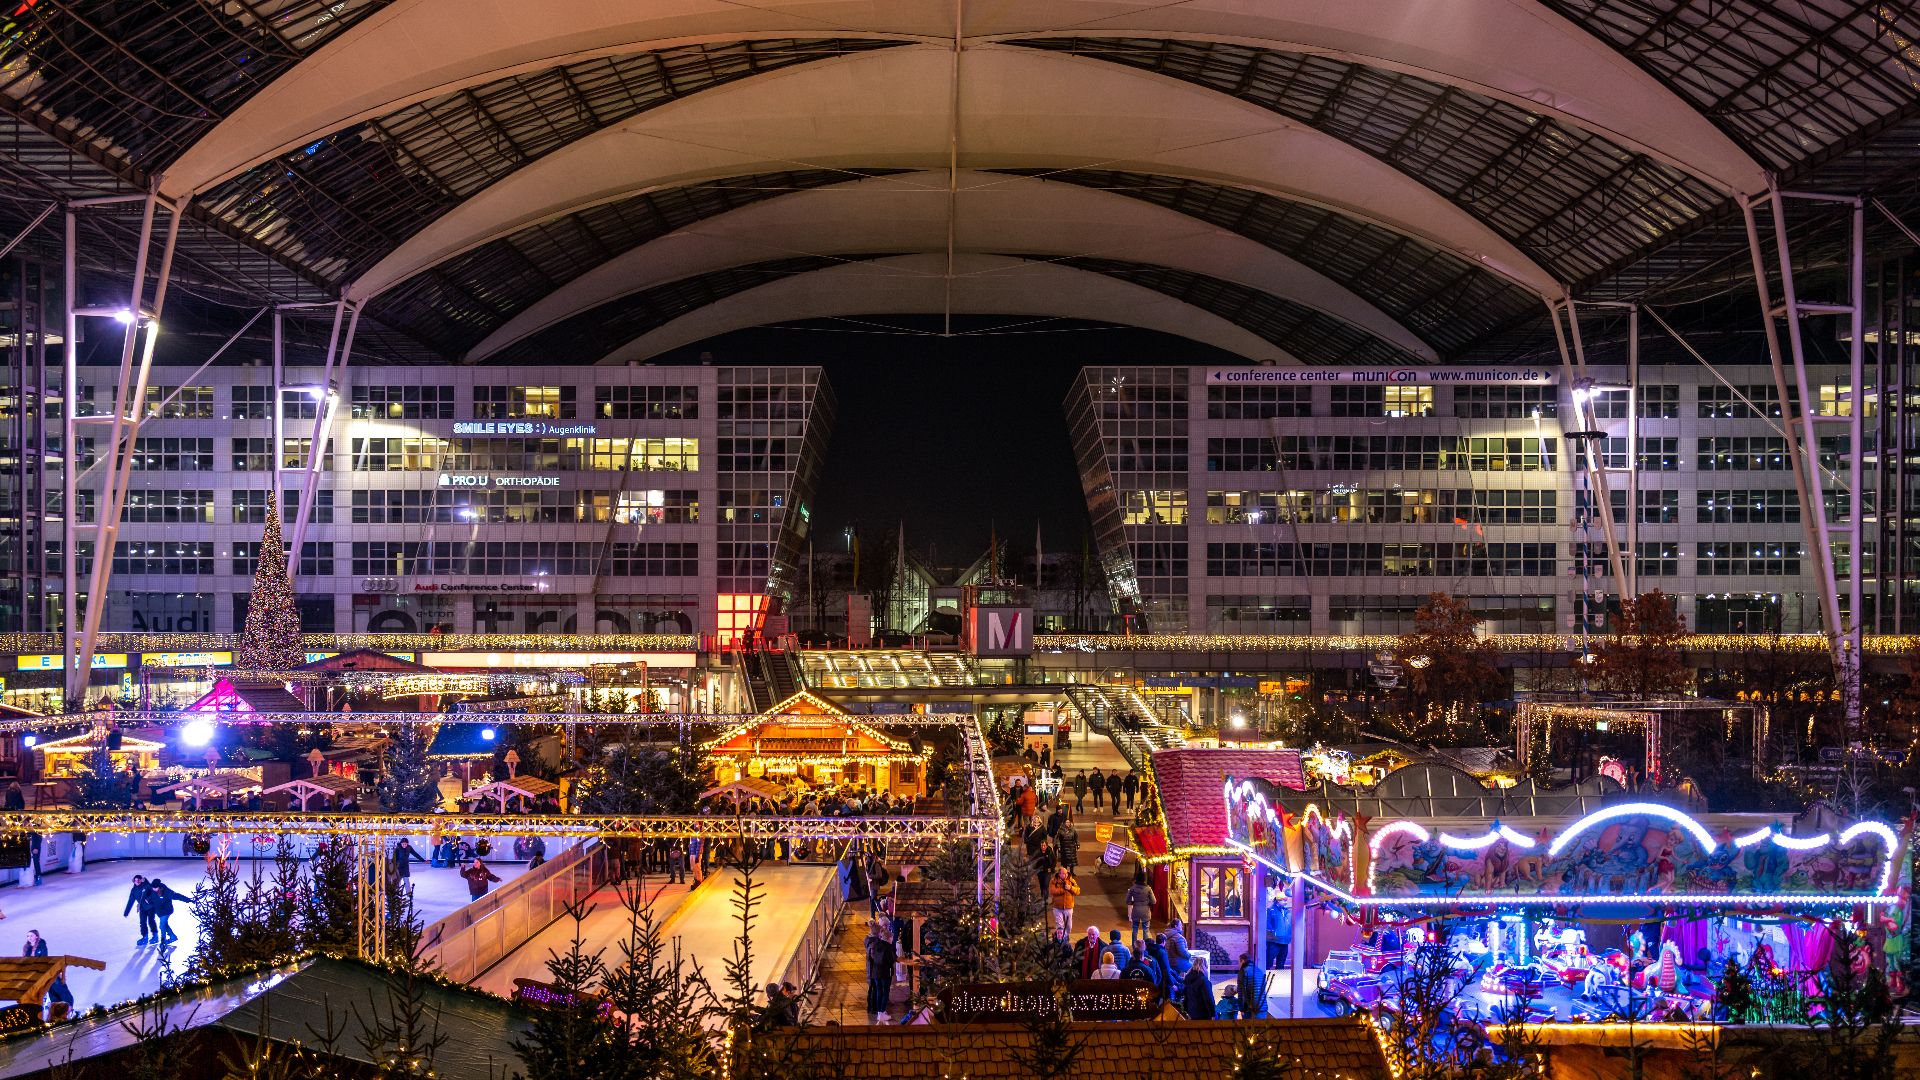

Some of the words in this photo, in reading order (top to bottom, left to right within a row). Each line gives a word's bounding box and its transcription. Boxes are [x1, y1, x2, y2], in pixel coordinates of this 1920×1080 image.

[1226, 369, 1296, 382] conference
[1300, 370, 1341, 382] center
[1429, 369, 1538, 382] www.municon.de
[453, 422, 495, 434] SMILE
[498, 422, 533, 434] EYES
[549, 425, 596, 436] Augenklinik
[453, 475, 477, 486] PRO
[478, 475, 488, 486] U
[495, 475, 560, 486] ORTHOPÄDIE
[414, 583, 439, 592] Audi
[441, 583, 498, 592] Conference
[500, 583, 536, 592] Center
[132, 610, 209, 632] Audi
[988, 612, 1022, 650] M
[534, 653, 587, 665] BAYERN
